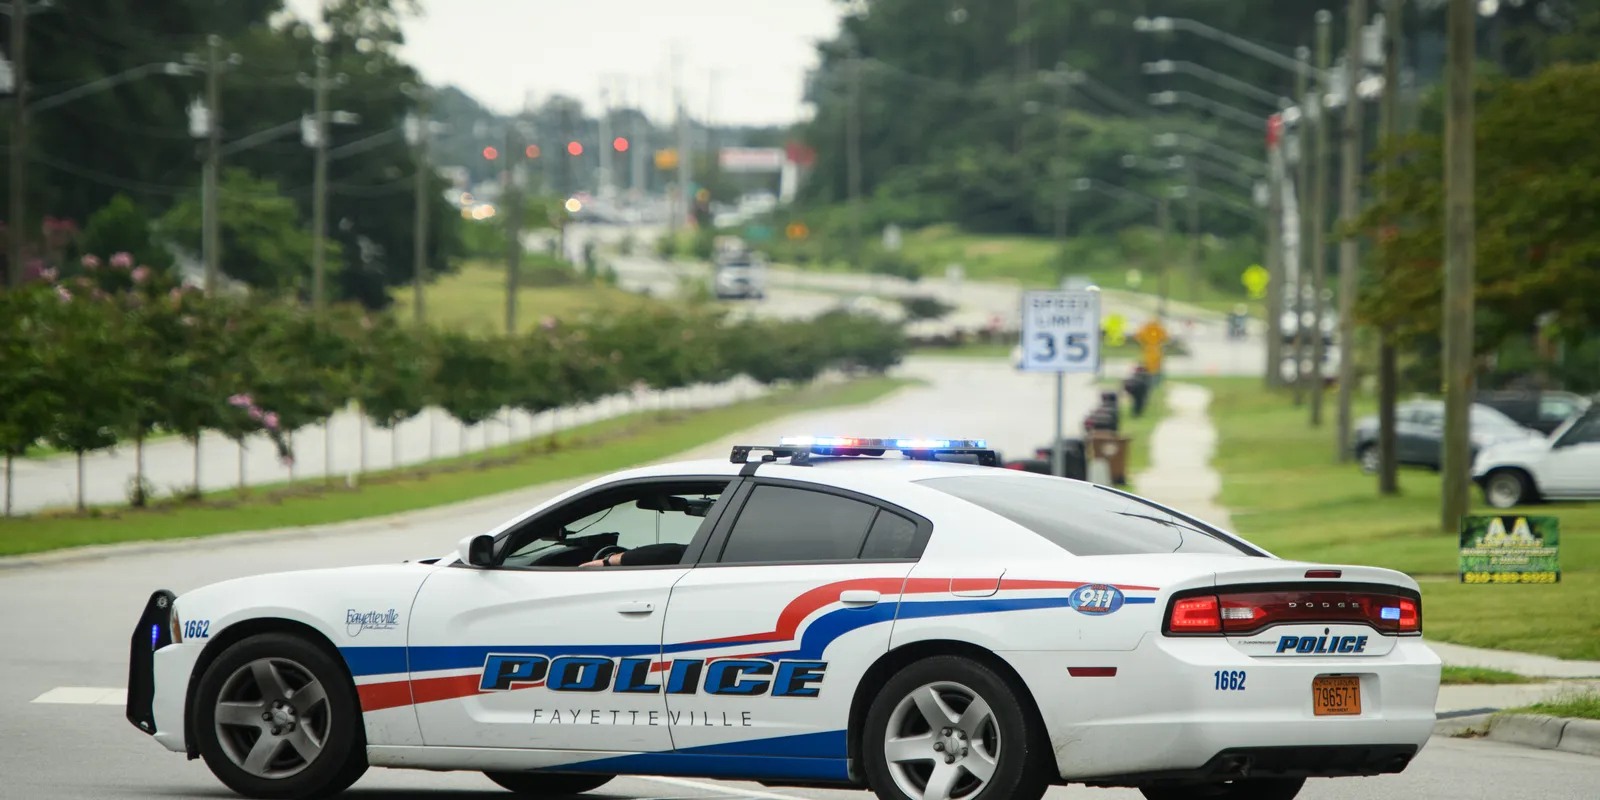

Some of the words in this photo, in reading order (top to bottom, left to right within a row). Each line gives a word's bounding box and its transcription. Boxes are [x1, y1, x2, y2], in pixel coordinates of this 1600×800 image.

[1033, 298, 1090, 309] SPEED
[1034, 314, 1085, 327] LIMIT
[1033, 332, 1090, 362] 35
[183, 620, 210, 639] 1662
[345, 609, 399, 637] Fayetteville
[1276, 635, 1369, 654] POLICE
[478, 652, 831, 698] POLICE
[1214, 670, 1246, 690] 1662
[532, 709, 753, 726] FAYETTEVILLE
